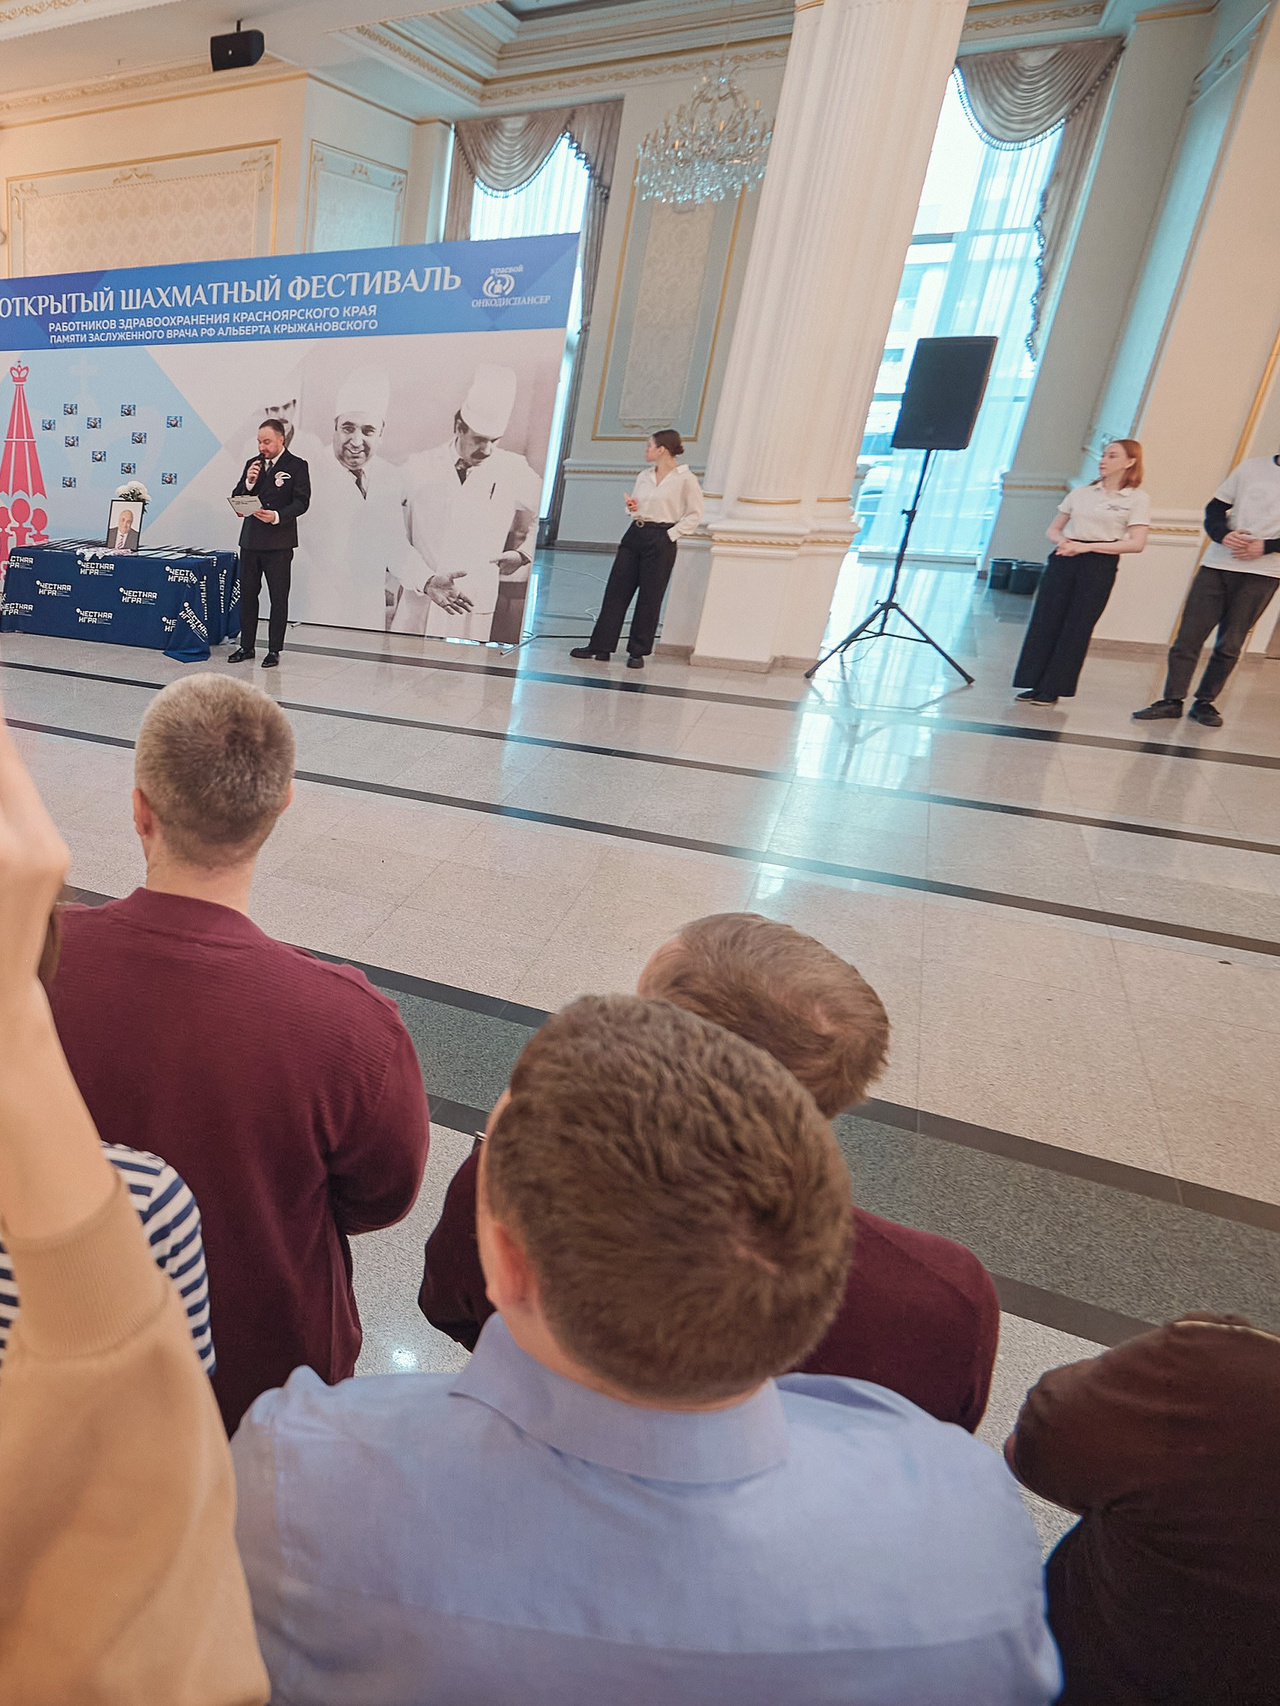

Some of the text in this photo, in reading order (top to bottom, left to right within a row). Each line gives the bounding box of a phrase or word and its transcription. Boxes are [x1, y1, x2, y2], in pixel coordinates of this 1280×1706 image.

[120, 273, 282, 311] ШАХМАТНЫЙ
[288, 265, 462, 301] ФЕСТИВАЛЬ
[472, 295, 551, 308] ОНКОДИСПАНСЕР
[48, 304, 378, 333] РАБОТНИКОВ ЗДРАВООХРАНЕНИЯ КРАСНОЯРСКОГО КРАЯ
[49, 319, 379, 344] ПАМЯТИ ЗАСЛУЖЕННОГО ВРАЧА РФ АЛЬБЕРТА КРЫЖАНОВСКОГО
[81, 562, 115, 571] ЧЕСТНАЯ
[80, 568, 100, 576] ИГРА
[167, 575, 189, 583] ИГРА
[40, 582, 72, 592] ЧЕСТНАЯ
[38, 588, 57, 596] ИГРА
[123, 590, 158, 599] ЧЕСТНАЯ
[121, 596, 142, 604] ИГРА
[79, 610, 113, 619] ЧЕСТНАЯ
[78, 616, 97, 624] ИГРА
[179, 610, 197, 630] ИГРА
